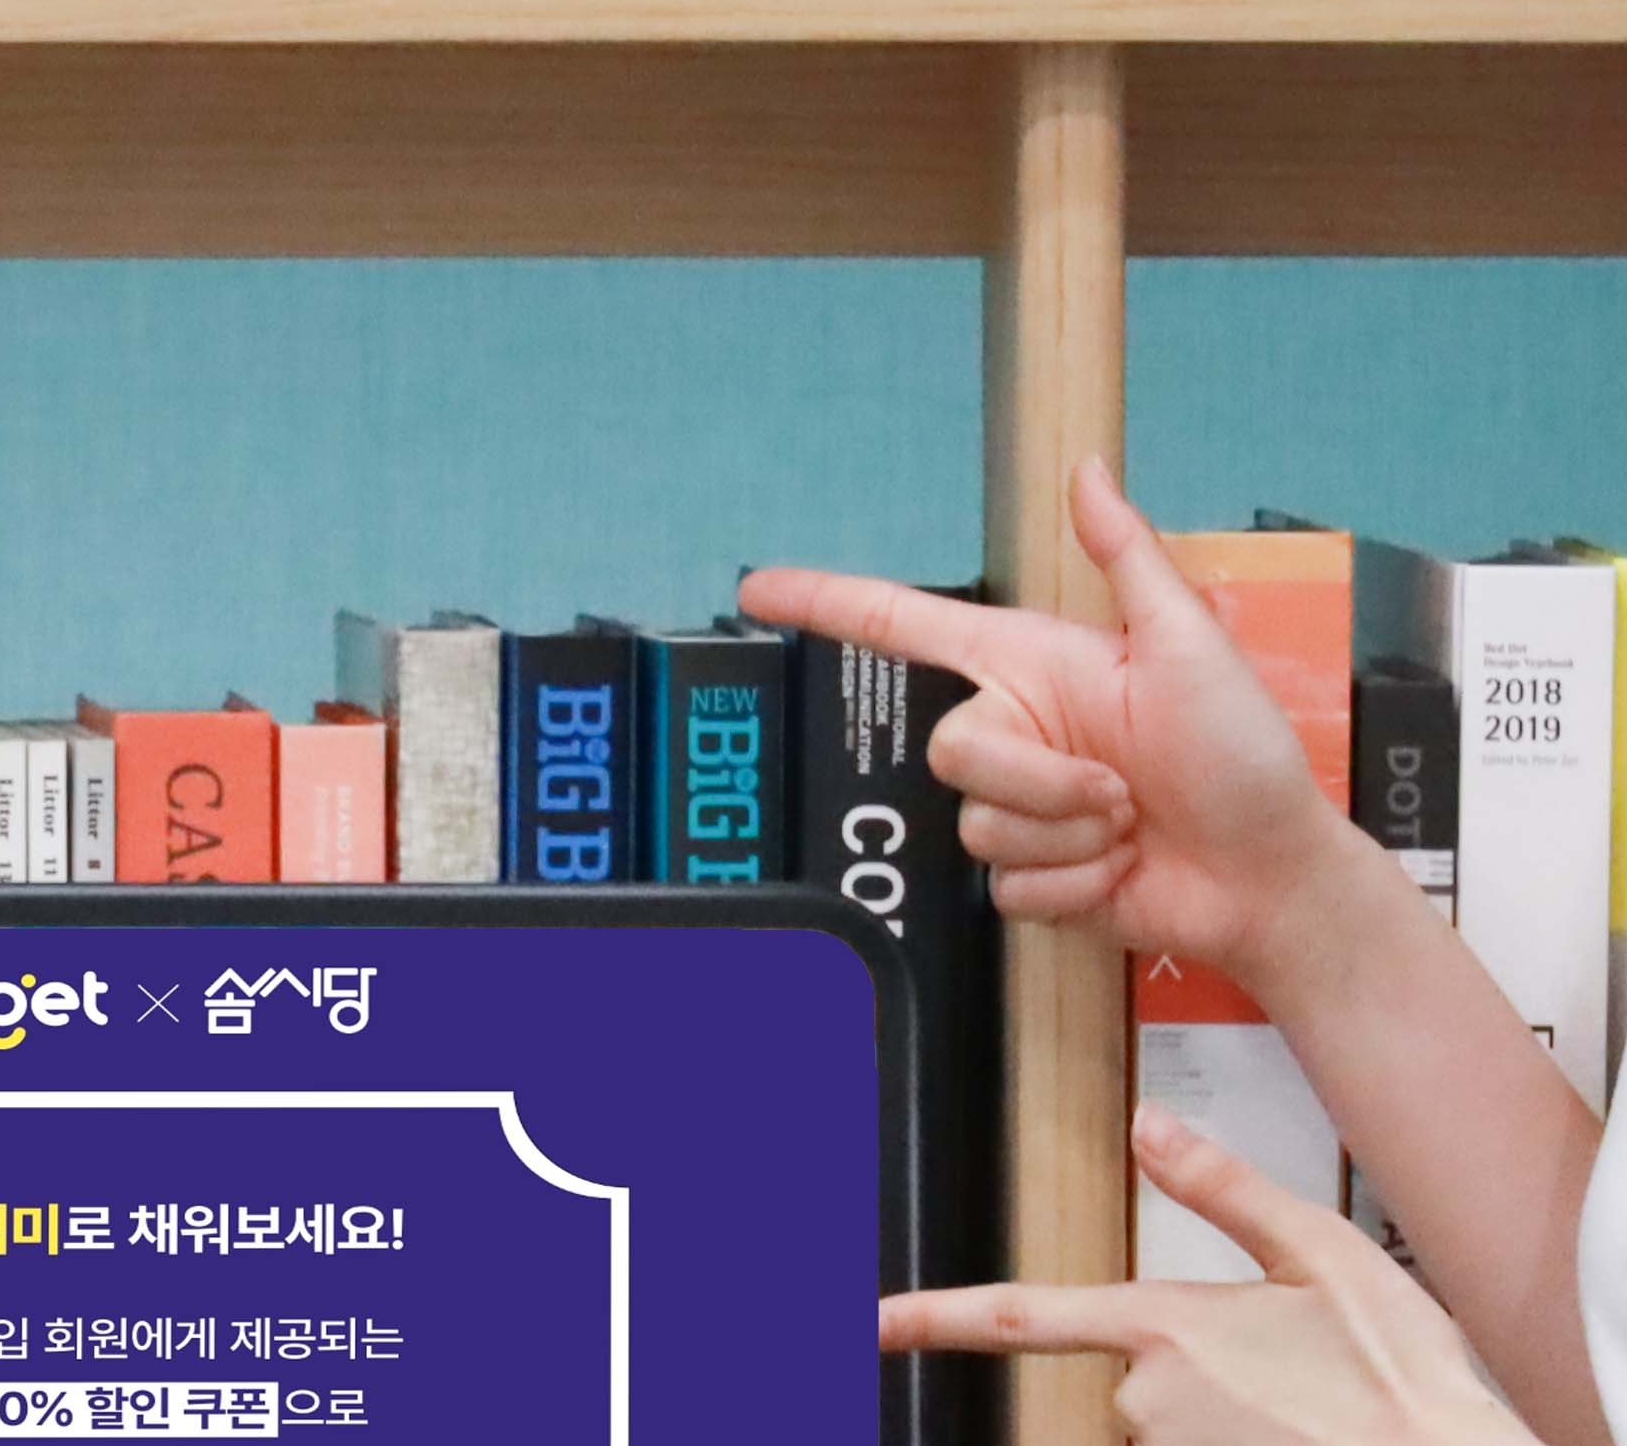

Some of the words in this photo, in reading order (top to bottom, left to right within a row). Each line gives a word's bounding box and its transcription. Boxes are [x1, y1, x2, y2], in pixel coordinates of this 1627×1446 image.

[690, 686, 759, 713] NEW
[857, 648, 873, 775] OMMUNICATION
[1484, 677, 1562, 706] 2018
[1484, 714, 1562, 743] 2019
[204, 968, 377, 1034] 솜씨당
[128, 1204, 403, 1255] 채워보세요!
[45, 1318, 215, 1359] 회원에게
[231, 1317, 403, 1359] 제공되는
[85, 1384, 172, 1434] 할인
[183, 1384, 369, 1434] 쿠폰으로
